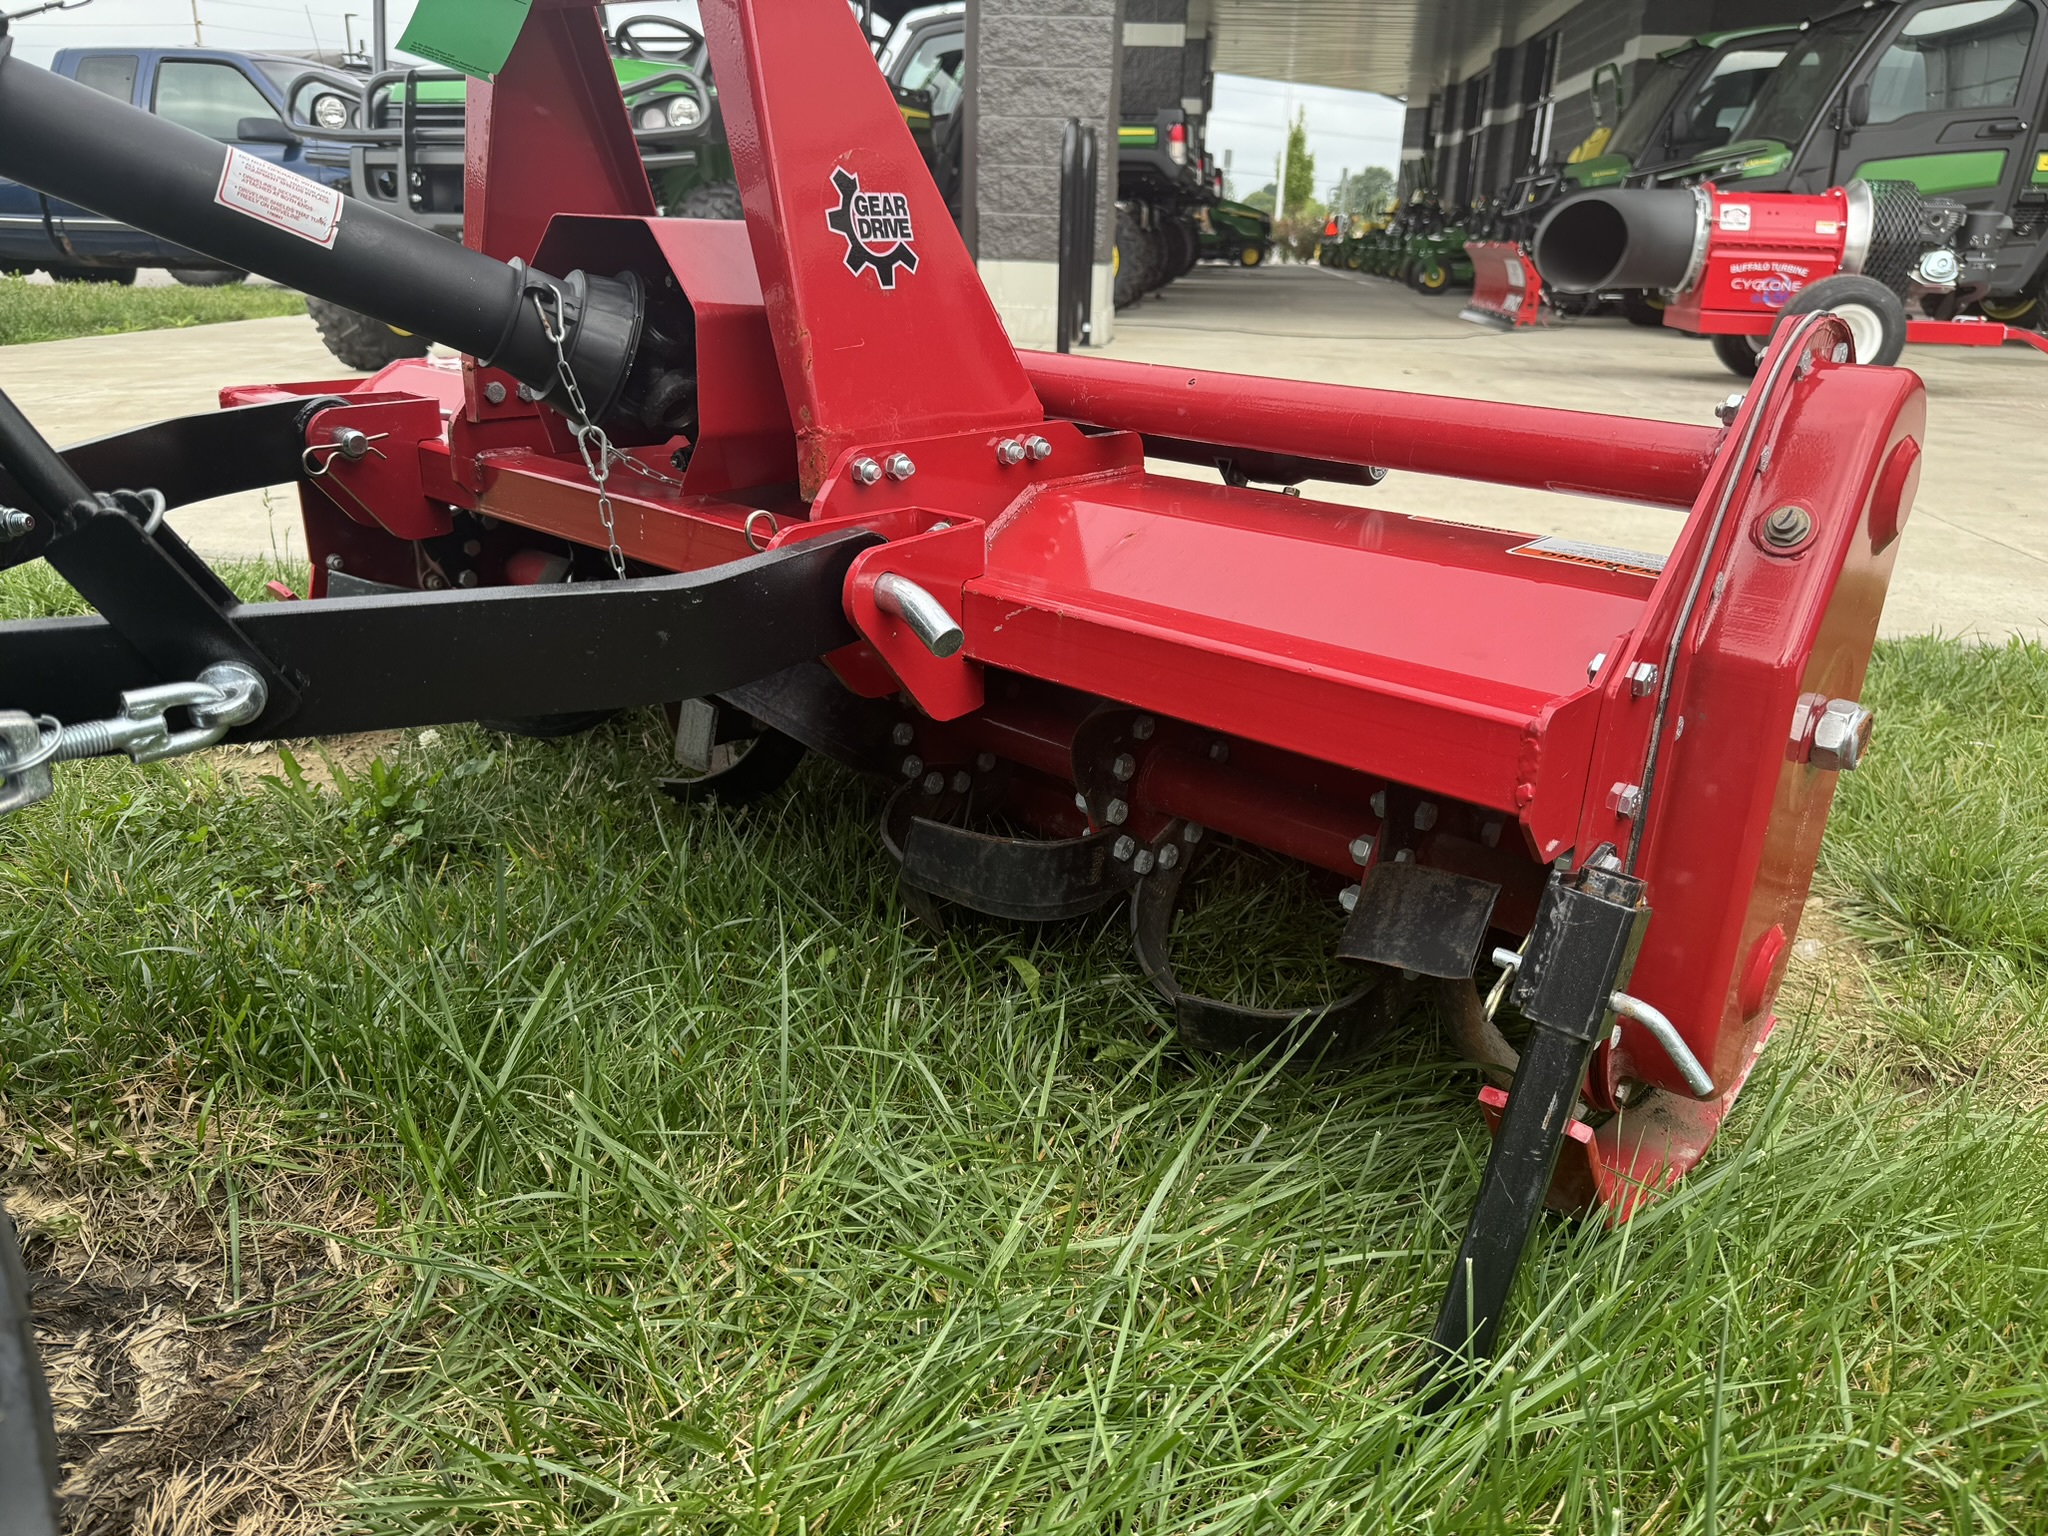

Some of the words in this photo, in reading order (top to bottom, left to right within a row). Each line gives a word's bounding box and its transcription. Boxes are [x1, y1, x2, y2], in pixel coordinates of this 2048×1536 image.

[241, 177, 272, 194] ATTACHED
[280, 194, 297, 204] BOTH
[297, 201, 313, 211] ENDS
[242, 173, 277, 191] DRIVELINES
[278, 188, 307, 203] SECURELY
[236, 191, 259, 204] FREELY
[270, 205, 300, 221] DRIVELINE
[238, 185, 269, 202] DRIVELINE
[270, 199, 295, 213] SHIELDS
[295, 210, 310, 219] THAT
[310, 217, 326, 226] TURN
[854, 195, 908, 216] GEAR
[858, 218, 912, 239] DRIVE
[1730, 262, 1771, 274] BUFFALO
[1771, 262, 1810, 278] TURBINE
[1730, 278, 1803, 292] CYCLONE
